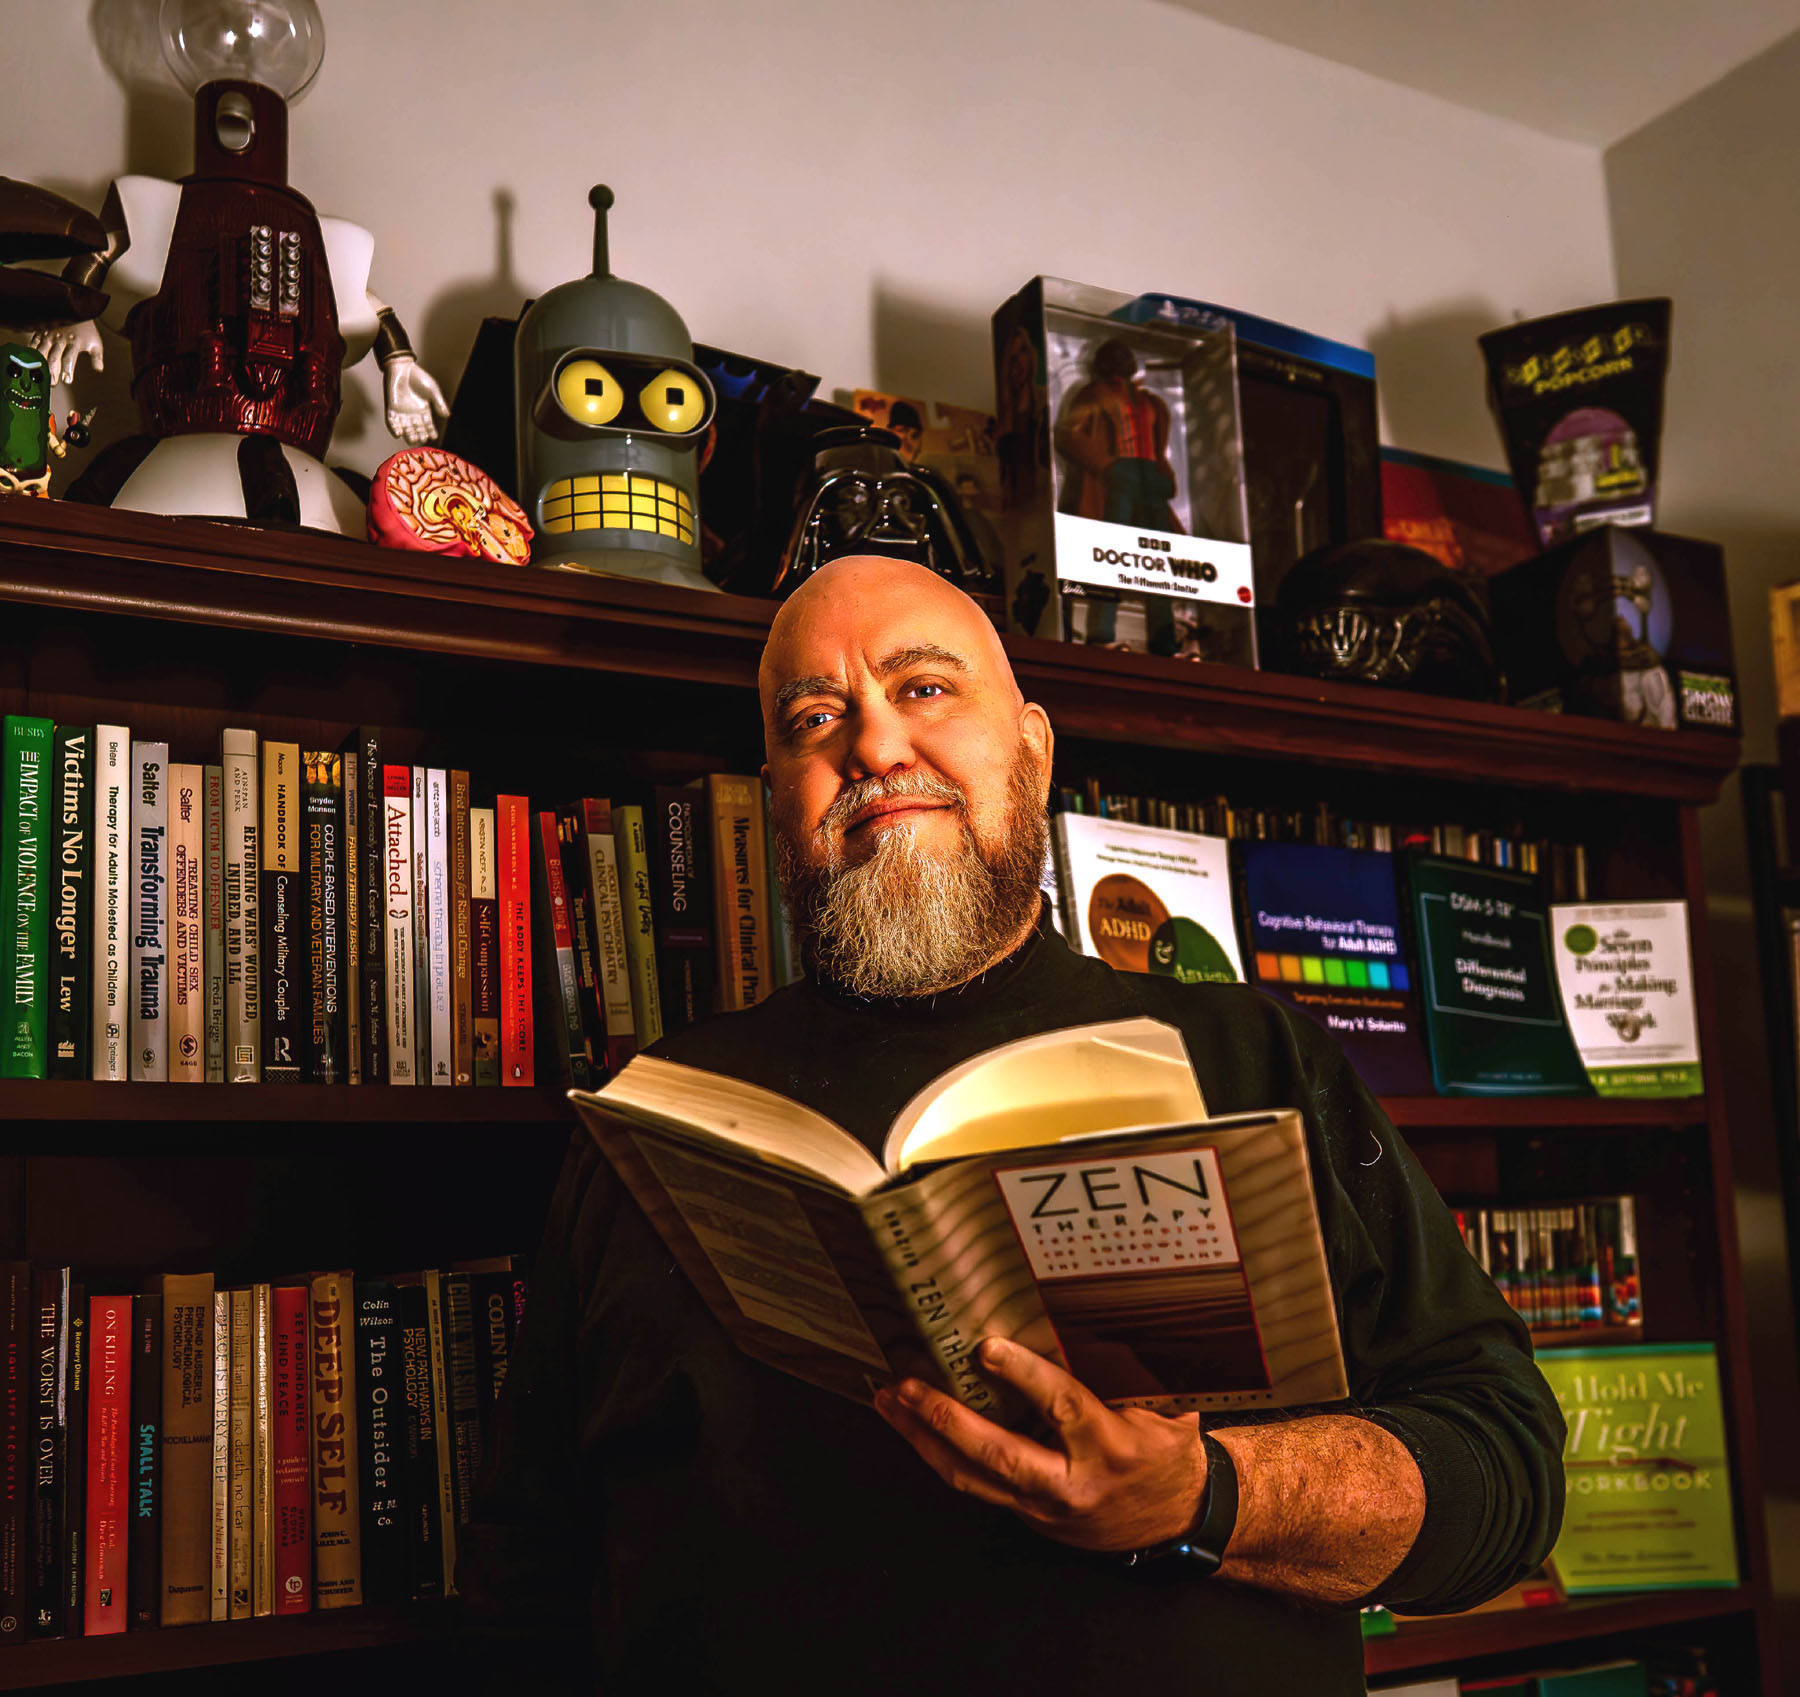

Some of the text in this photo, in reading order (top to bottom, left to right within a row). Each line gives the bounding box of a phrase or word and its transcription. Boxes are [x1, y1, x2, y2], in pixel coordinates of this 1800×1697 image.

[1533, 354, 1634, 396] POPCORN
[1092, 547, 1218, 583] DOCTOR WHO
[13, 726, 46, 739] BUSBY
[20, 751, 40, 763] THE
[109, 741, 119, 768] Briere
[141, 762, 161, 807] Salter
[276, 752, 285, 776] Moore
[179, 787, 194, 824] Salter
[276, 784, 287, 870] HANDBOOK OF
[56, 735, 86, 960] Victims No Longer
[209, 776, 221, 930] FROM VICTIM TO OFFENDER
[243, 826, 258, 904] RETURNING
[386, 803, 408, 903] Attached.
[416, 851, 425, 879] Solution
[667, 801, 688, 912] COUNSELING
[731, 815, 752, 887] Measures
[14, 763, 39, 1008] IMPACT OF VIOLENCE ON THE FAMILY
[105, 786, 119, 1007] Therapy for Adults Molested as Children
[347, 835, 359, 969] FAMILY THERAPY BASICS
[415, 880, 425, 906] Building
[454, 783, 468, 979] Brief Interventions for Radical Change
[549, 858, 567, 931] Brainspotting
[594, 849, 609, 908] CLINICAL
[736, 888, 754, 912] for
[134, 826, 165, 1021] Transforming Trauma
[175, 844, 188, 1006] OFFENDERS AND VICTIMS
[187, 858, 200, 992] TREATING CHILD SEX
[226, 862, 242, 985] INJURED, AND ILL
[310, 823, 325, 1045] FOR MILITARY AND VETERAN FAMILIES
[323, 823, 338, 1013] COUPLE-BASED INTERVENTIONS
[600, 909, 619, 986] PSYCHIATRY
[737, 915, 760, 972] Clinical
[1099, 917, 1152, 942] ADHD
[1256, 909, 1396, 939] Cognitive Behavioral Therapy
[1337, 934, 1366, 953] Adult
[1366, 937, 1398, 956] ADHD
[273, 876, 288, 1022] Counseling Military Couples
[477, 904, 493, 1013] Self-Compassion
[516, 901, 527, 1052] THE BODY KEEPS THE SCORE
[1454, 956, 1528, 984] Differential
[59, 975, 76, 1013] Lew
[211, 975, 224, 1007] Freda
[243, 954, 260, 1024] WOUNDED,
[1460, 976, 1526, 1002] Diagnosis
[1614, 975, 1679, 997] Making
[108, 1041, 118, 1072] Springer
[207, 1008, 223, 1044] Briggs
[1018, 1158, 1210, 1219] ZEN
[1032, 1206, 1213, 1236] THERAPY
[39, 1302, 56, 1338] THE
[194, 1305, 205, 1346] EDMUND
[294, 1311, 305, 1338] SET
[358, 1317, 395, 1327] Wilson
[361, 1300, 391, 1310] Colin
[488, 1293, 508, 1358] COLIN
[910, 1276, 951, 1324] ZEN
[73, 1331, 82, 1391] Recovery Dharma
[103, 1309, 116, 1396] ON KILLING
[172, 1306, 184, 1369] PSYCHOLOGY
[181, 1306, 194, 1409] PHENOMENOLOGICAL
[313, 1299, 343, 1404] DEEP
[448, 1282, 479, 1412] COLIN WILSON
[39, 1345, 56, 1407] WORST
[215, 1314, 229, 1483] PEACE IS EVERY STEP
[278, 1333, 290, 1417] FIND PEACE
[402, 1328, 418, 1409] PSYCHOLOGY
[414, 1327, 432, 1441] NEW PATHWAYS IN
[1573, 1370, 1706, 1403] Hold Me
[39, 1414, 56, 1430] IS
[234, 1418, 245, 1435] no
[368, 1335, 390, 1490] The Outsider
[1564, 1401, 1689, 1467] Tight
[38, 1436, 55, 1487] OVER
[138, 1423, 155, 1518] SMALL TALK
[233, 1439, 250, 1480] death,
[314, 1411, 348, 1515] SELF
[1566, 1470, 1714, 1497] ORKBOOK
[234, 1484, 246, 1501] no
[234, 1503, 251, 1531] fear
[97, 1519, 107, 1581] Dave Grossman
